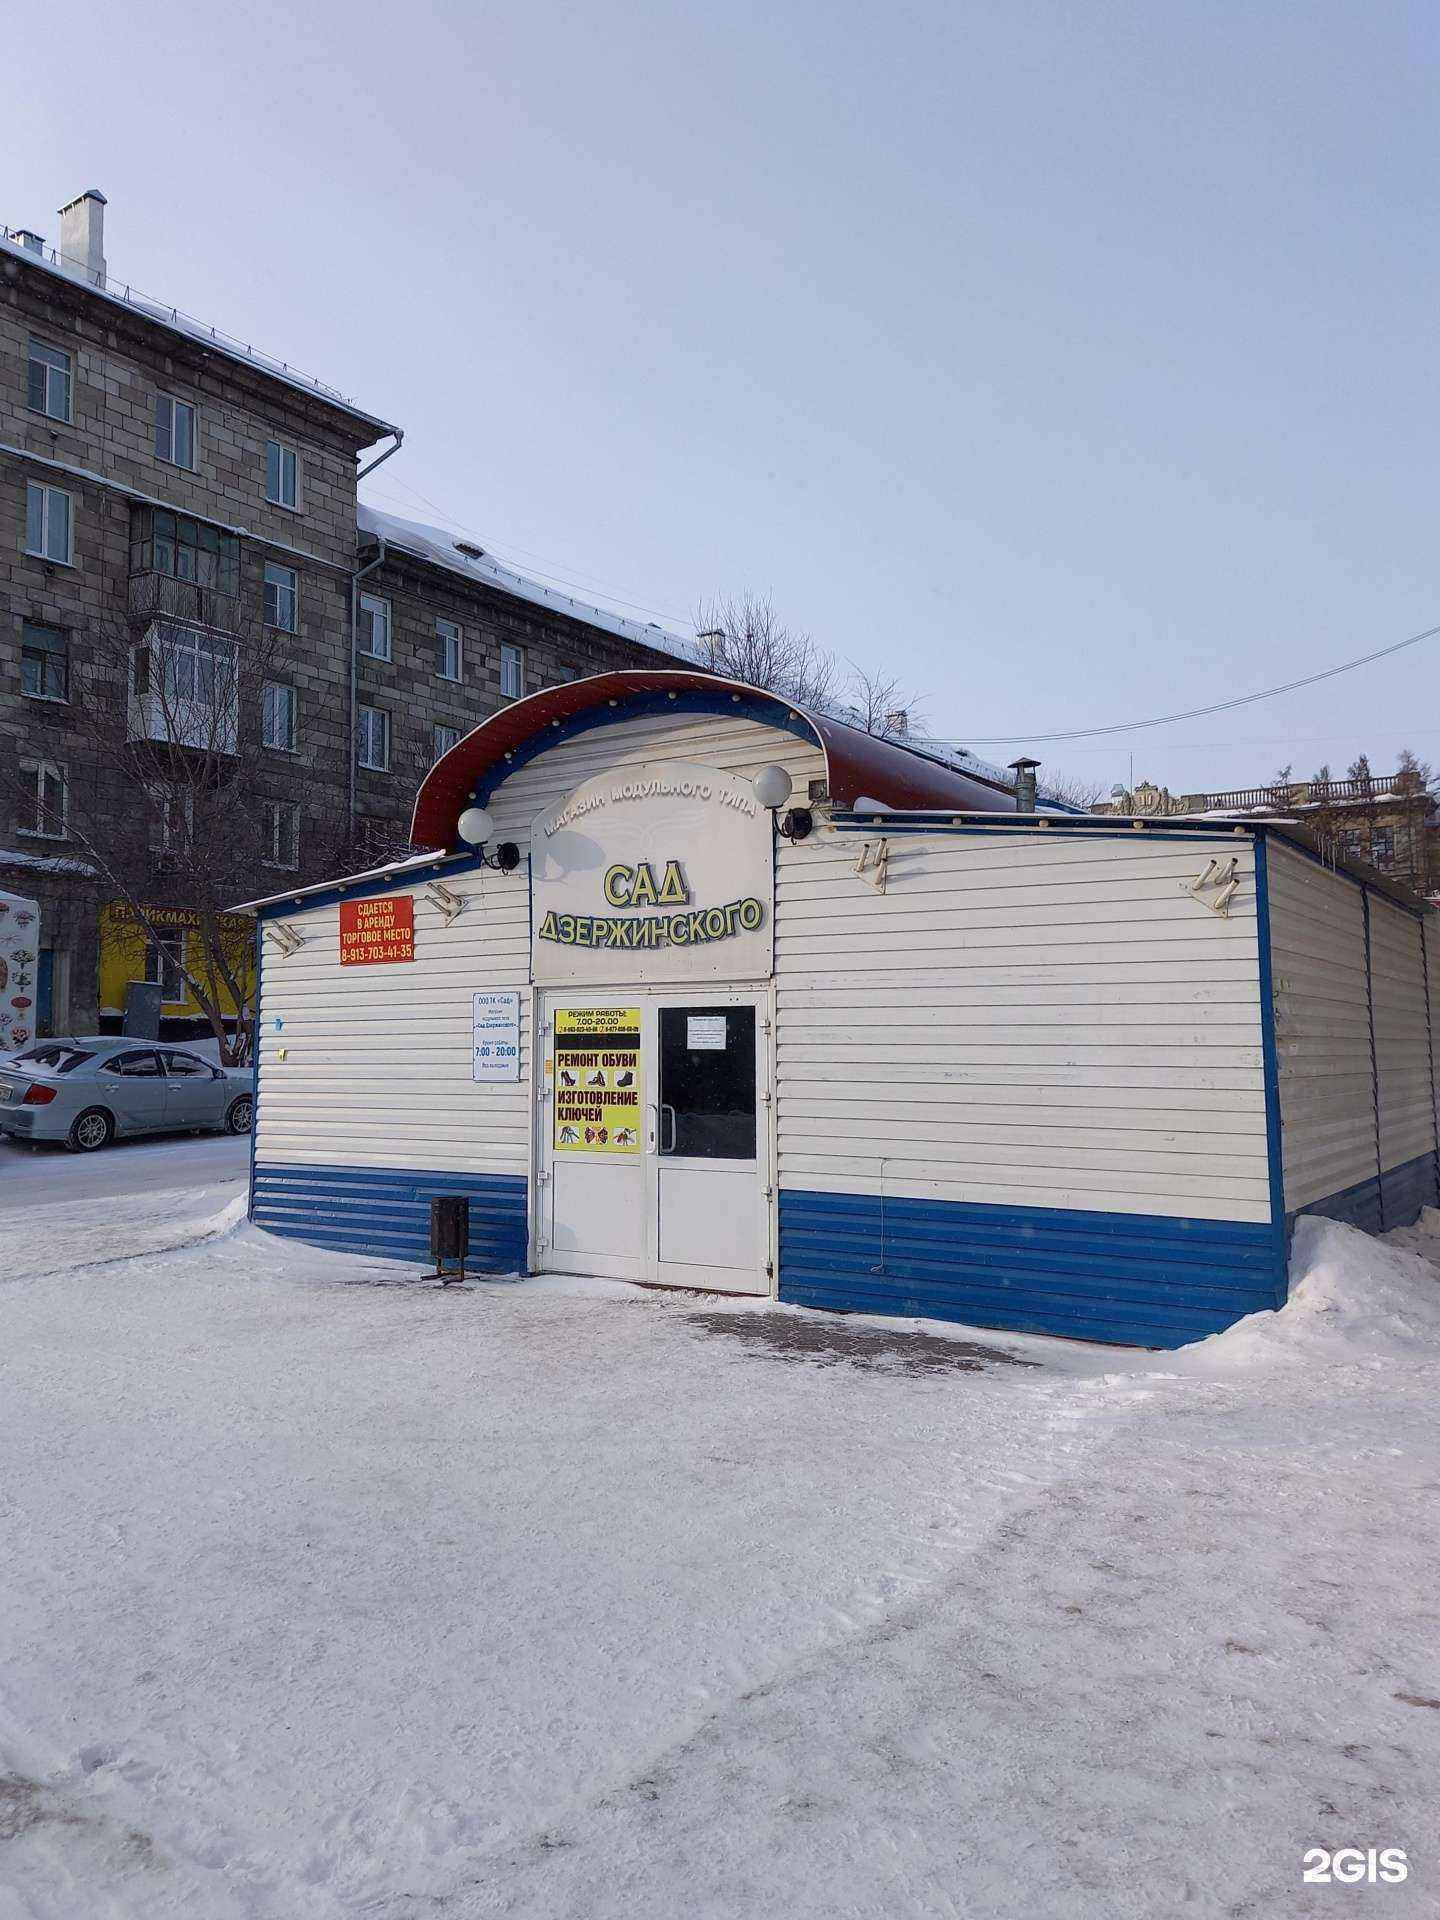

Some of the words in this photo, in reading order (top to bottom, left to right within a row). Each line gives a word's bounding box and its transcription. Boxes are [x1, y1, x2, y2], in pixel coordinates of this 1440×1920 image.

[604, 861, 689, 907] САД
[357, 902, 393, 916] СДАЕТСЯ
[357, 919, 362, 929] В
[364, 915, 395, 929] АРЕНДУ
[539, 898, 763, 949] ДЗЕРЖИНСКОГО
[342, 930, 381, 944] ТОРГОВОЕ
[384, 928, 410, 941] МЕСТО
[342, 944, 411, 961] 8-913-703-41-35
[558, 1054, 599, 1067] РЕМОНТ
[602, 1054, 636, 1067] ОБУВИ
[558, 1091, 638, 1105] ИЗГОТОВЛЕНИЕ
[558, 1107, 602, 1121] КЛЮЧЕЙ
